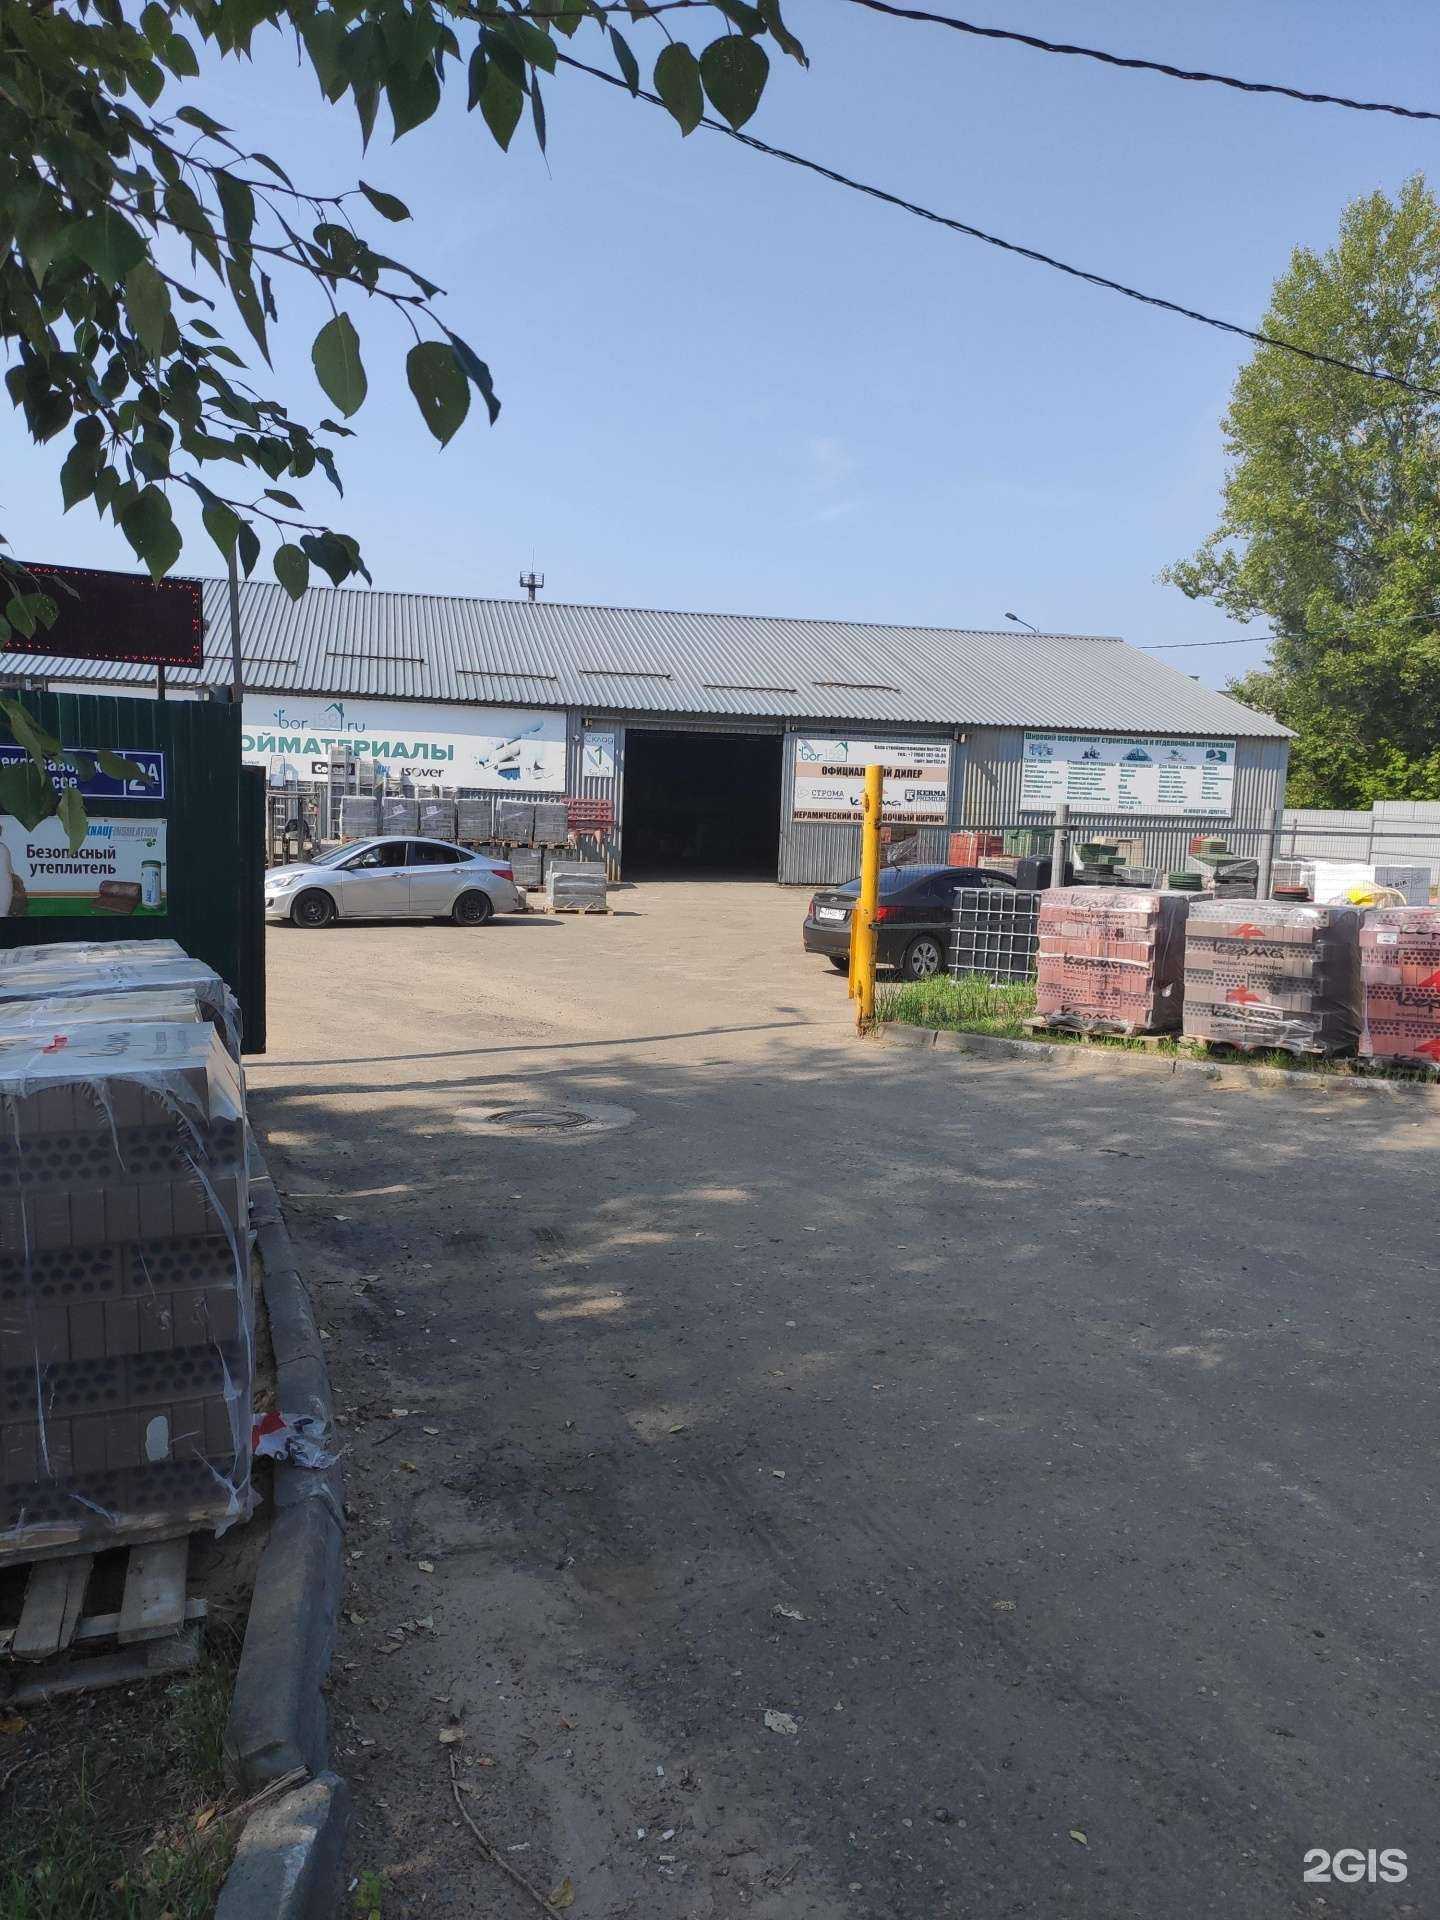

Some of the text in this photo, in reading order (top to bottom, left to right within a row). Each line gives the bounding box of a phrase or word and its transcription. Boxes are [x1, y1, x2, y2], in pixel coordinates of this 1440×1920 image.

[1025, 732, 1056, 741] Широкий
[1057, 734, 1101, 743] ассортимент
[1101, 736, 1148, 746] строительных
[822, 766, 922, 780] ОФИЦИАЛЙ ДИЛЕР
[811, 789, 845, 797] СТРОМА
[917, 789, 946, 797] KERMA
[793, 809, 945, 824] КЕРАМИЧЕСКИЙ ОБВОЧНЫЙ КИРПИЧ
[30, 862, 117, 877] утеплитель
